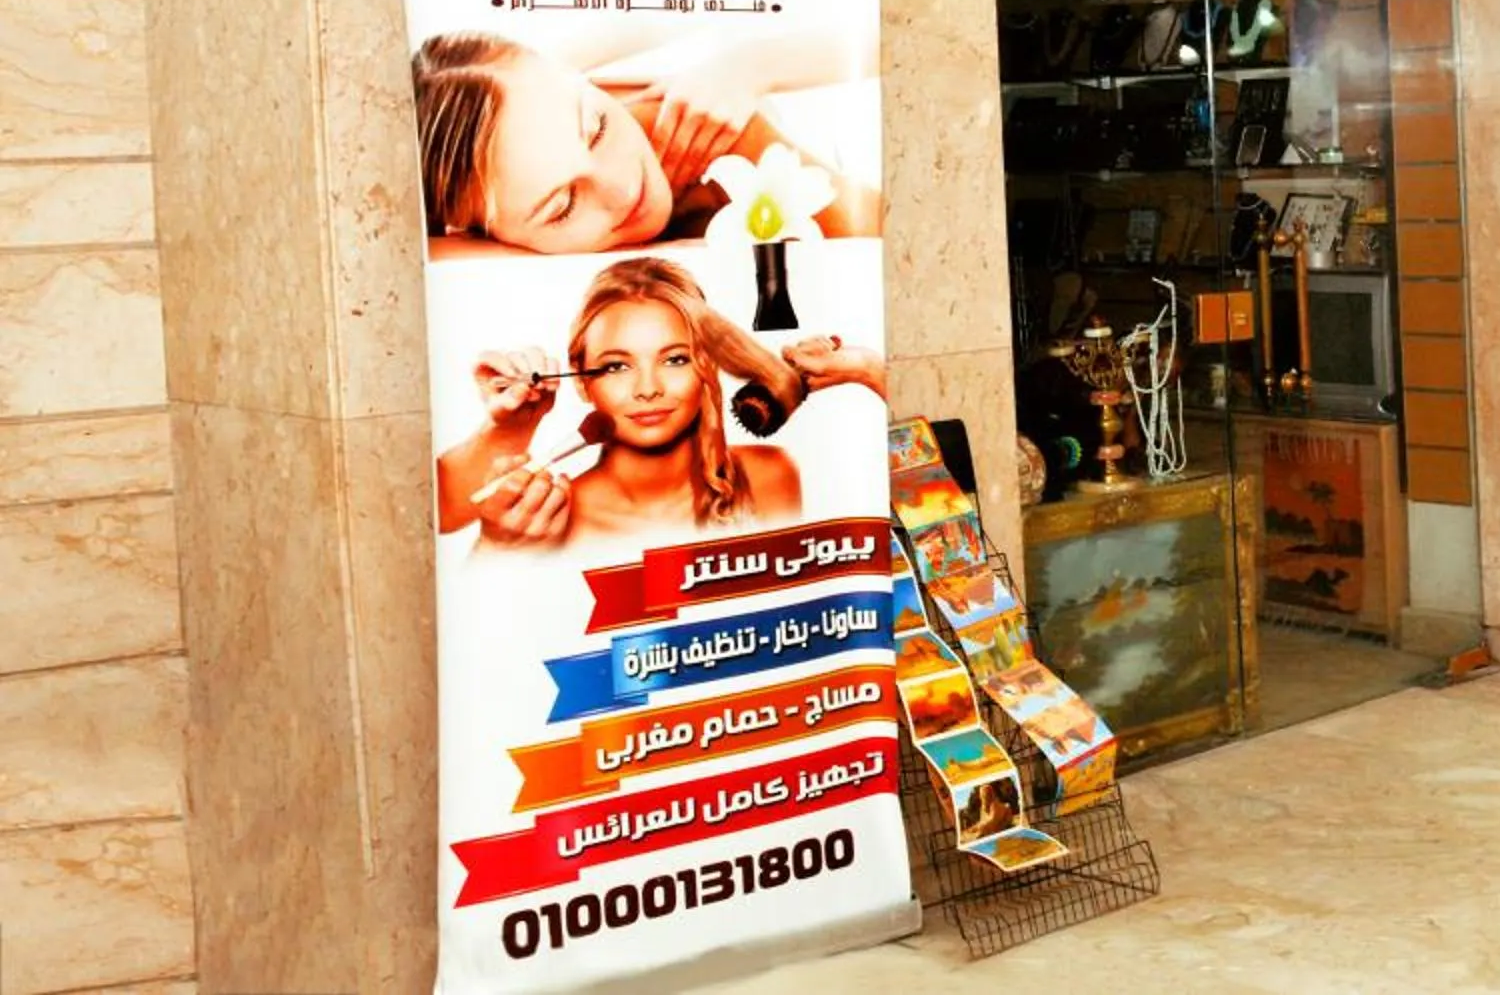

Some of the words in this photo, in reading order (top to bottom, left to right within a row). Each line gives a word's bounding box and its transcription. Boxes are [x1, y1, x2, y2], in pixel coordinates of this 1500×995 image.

[680, 552, 768, 591] سنتر
[773, 617, 808, 654] بخار
[821, 605, 878, 640] ساونا
[624, 643, 679, 679] بشرة
[681, 626, 757, 668] تنظيف
[804, 680, 882, 725] مساج
[700, 704, 779, 748] حمام
[795, 750, 885, 803] تجهيز
[703, 777, 790, 825] كامل
[556, 797, 695, 858] للعرائس
[501, 828, 856, 961] 01000131800
